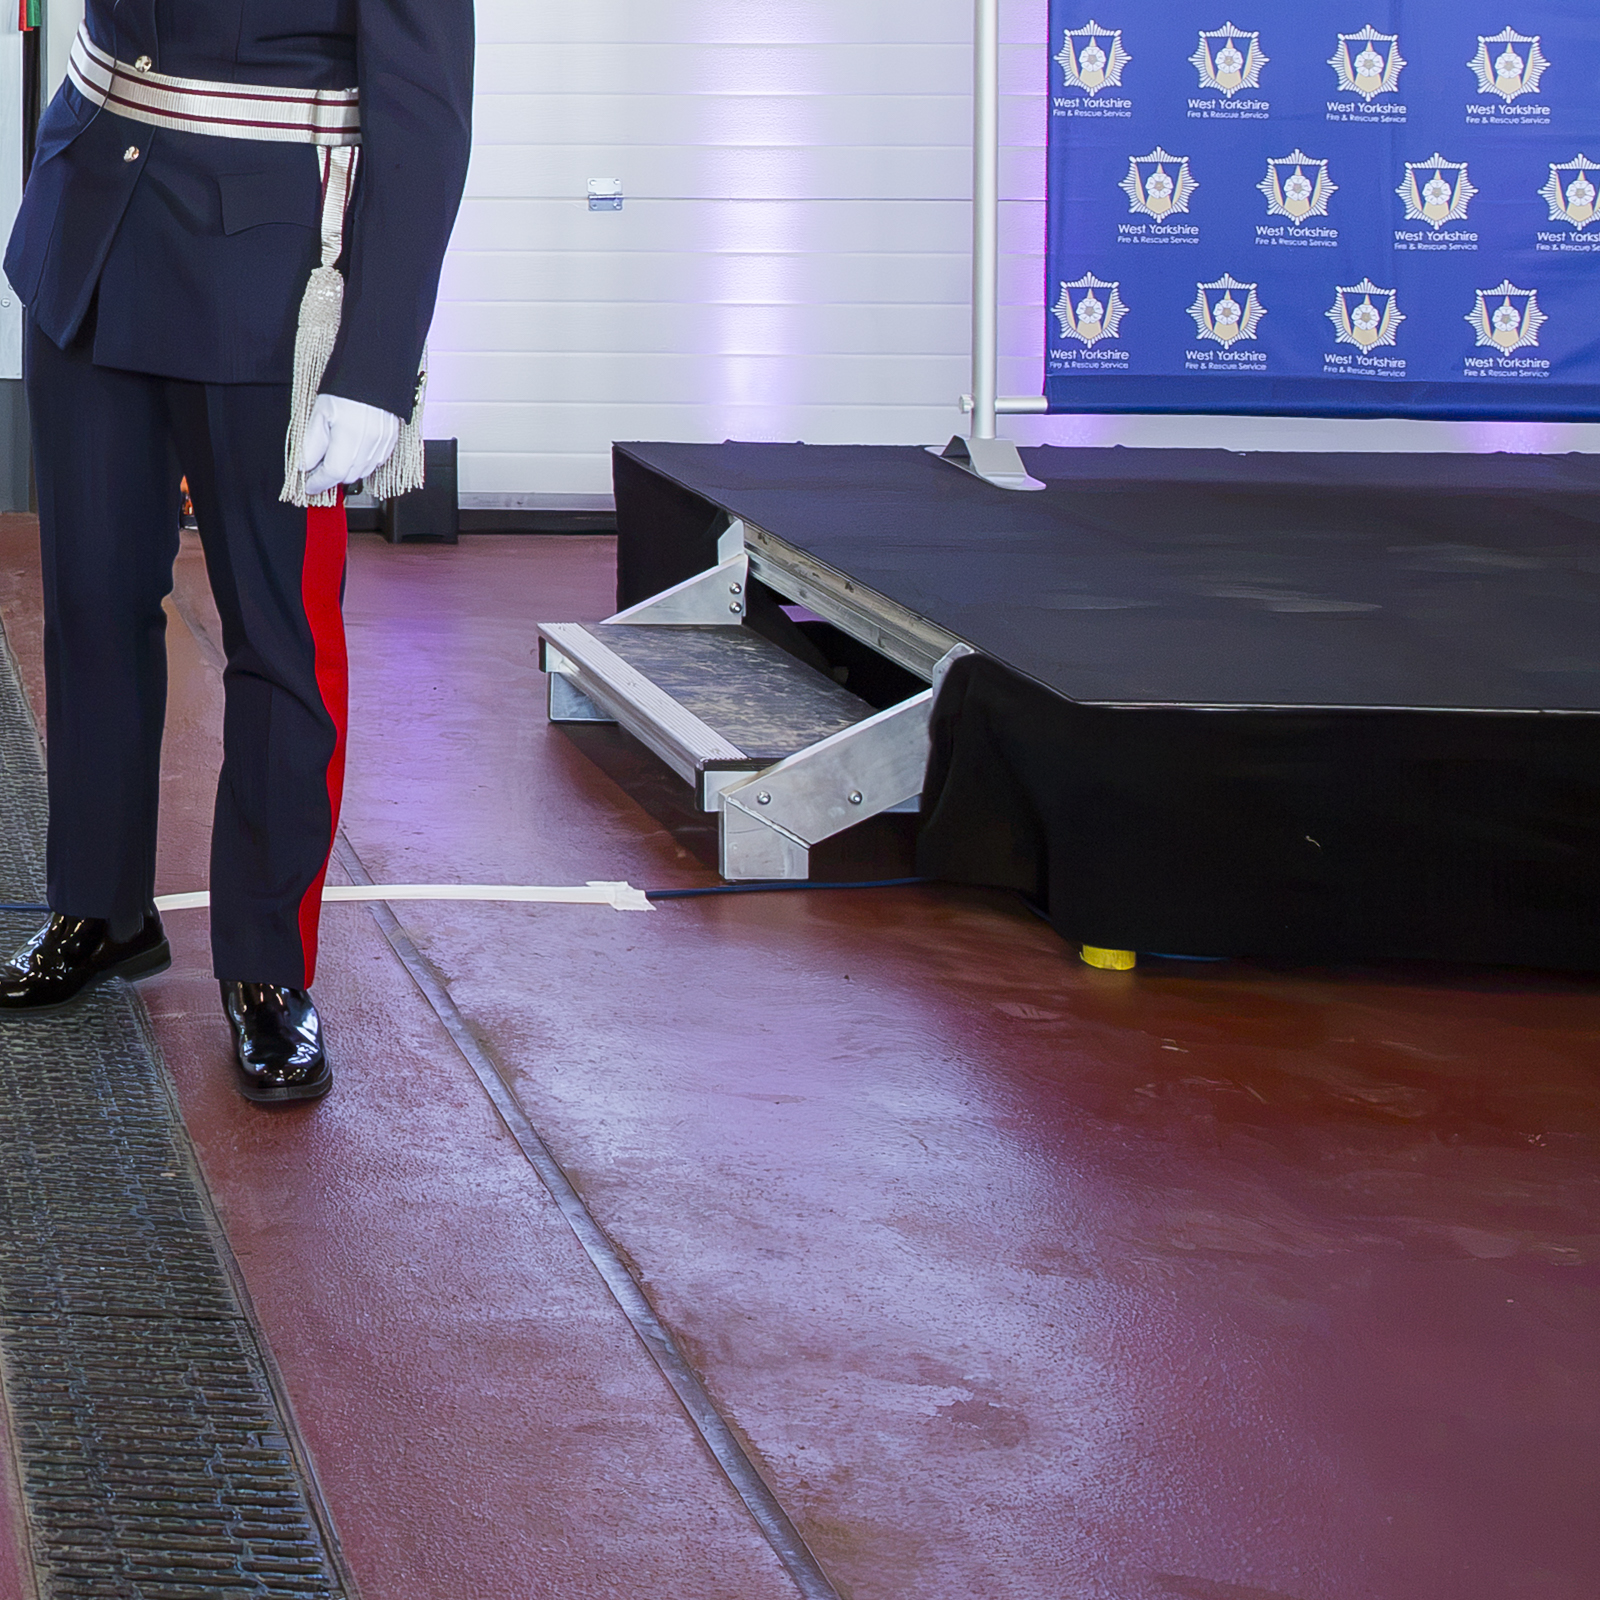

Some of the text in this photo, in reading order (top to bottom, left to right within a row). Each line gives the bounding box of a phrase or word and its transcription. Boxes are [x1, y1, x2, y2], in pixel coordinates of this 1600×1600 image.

[1053, 97, 1132, 109] West Yorkshire
[1187, 98, 1270, 110] West Yorkshire
[1326, 101, 1407, 114] West Yorkshire
[1465, 104, 1551, 115] West Yorkshire
[1118, 224, 1200, 235] West Yorkshire
[1255, 225, 1339, 238] West Yorkshire
[1394, 230, 1479, 242] West Yorkshire
[1536, 231, 1565, 242] West
[1049, 349, 1130, 360] West Yorkshire
[1185, 350, 1267, 362] West Yorkshire
[1324, 353, 1407, 368] West Yorkshire
[1464, 357, 1550, 369] West Yorkshire
